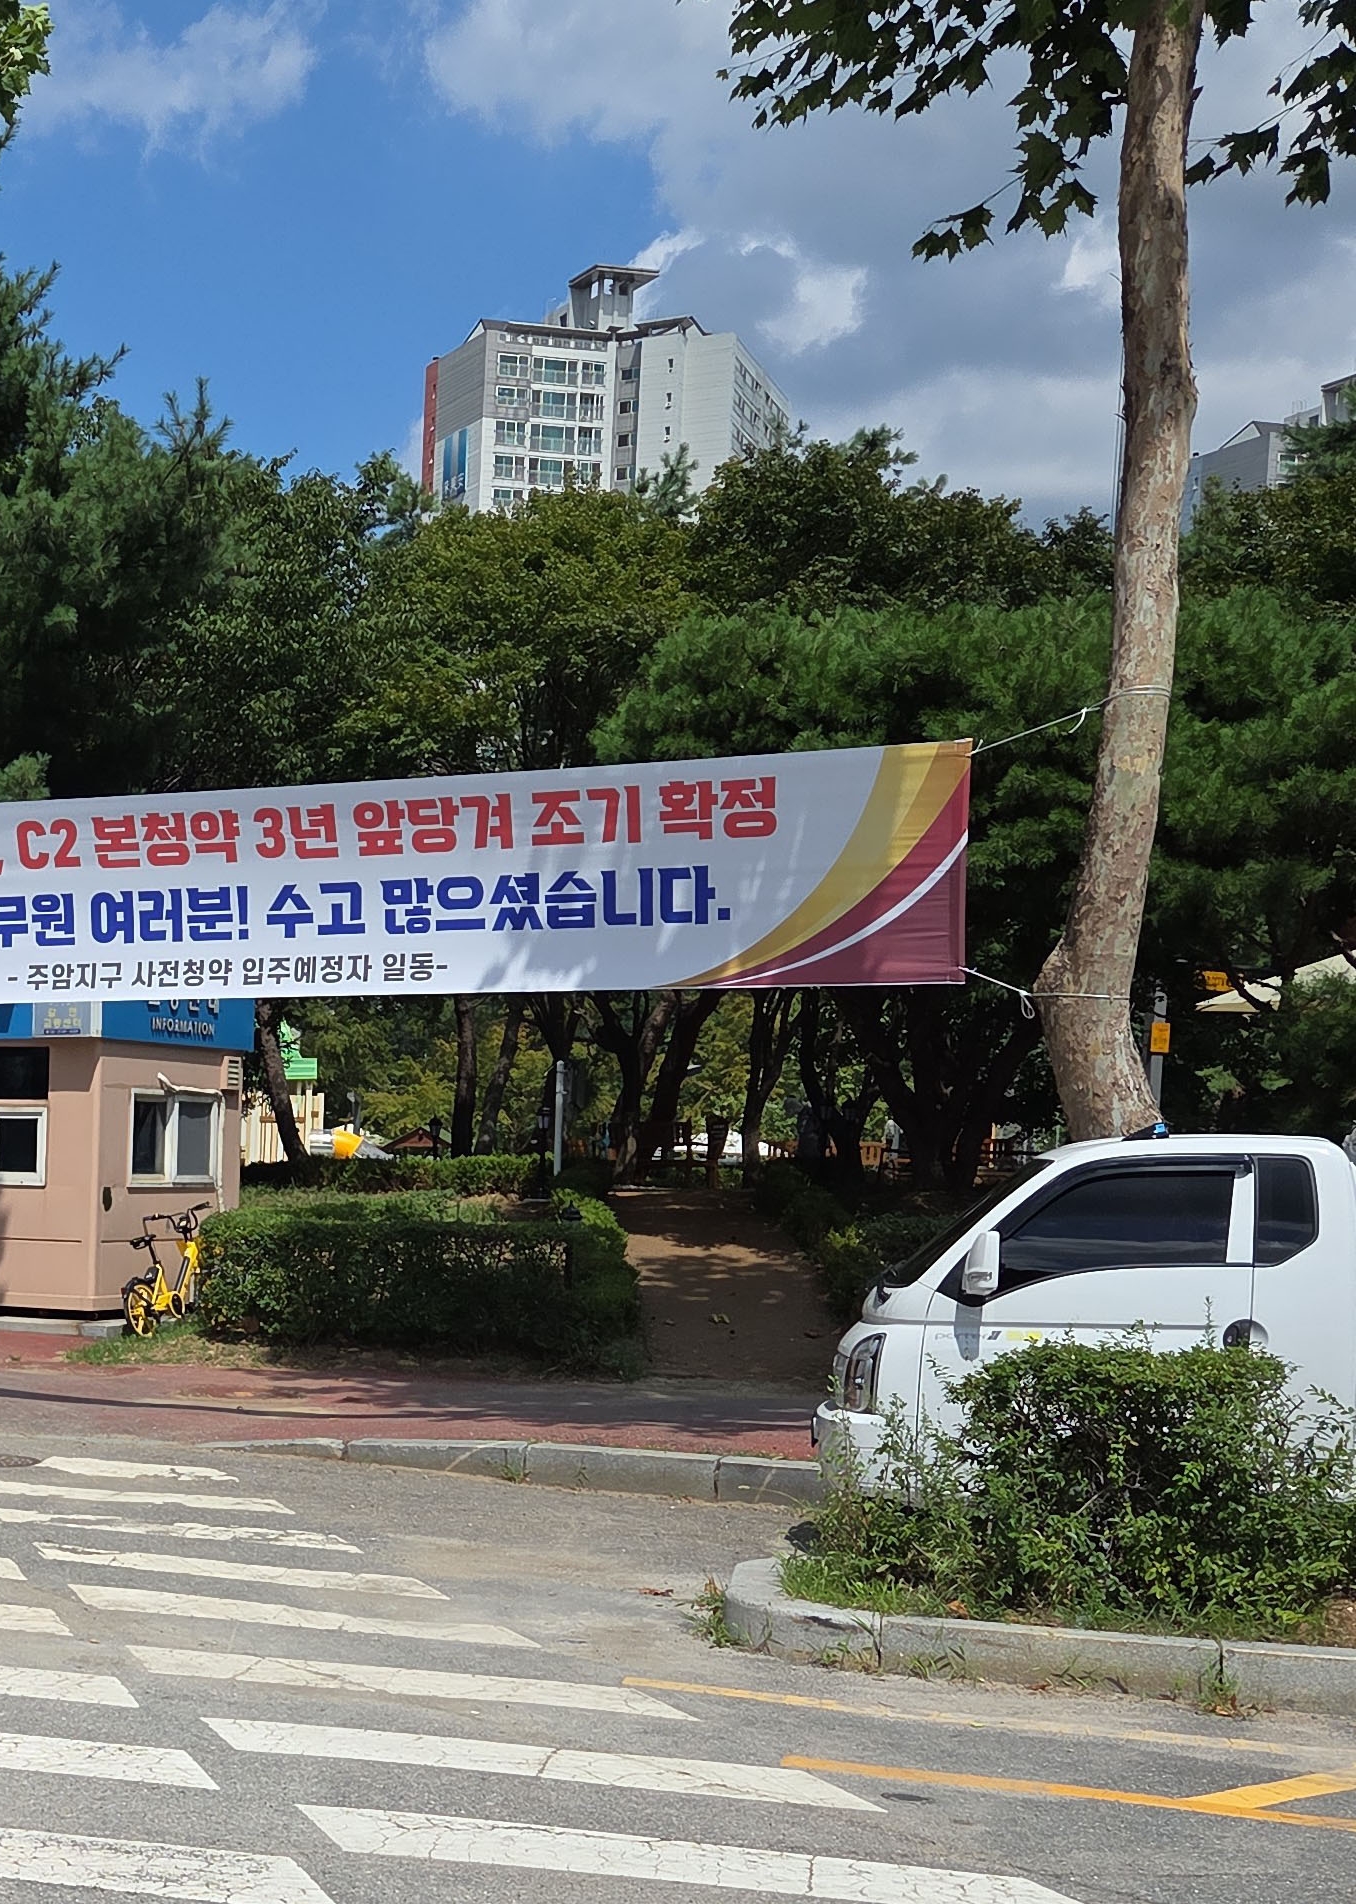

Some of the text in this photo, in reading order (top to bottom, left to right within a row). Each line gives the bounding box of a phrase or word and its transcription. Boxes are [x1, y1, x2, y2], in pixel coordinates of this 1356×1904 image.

[17, 820, 80, 869] C2
[93, 809, 239, 868] 본청약
[254, 805, 338, 859] 3년
[354, 793, 513, 856] 앞당겨
[532, 788, 640, 846] 조기
[660, 776, 776, 840] 확정
[90, 885, 250, 945] 여러분!
[265, 881, 367, 939] 수고
[380, 865, 731, 936] 많으셨습니다.
[26, 962, 123, 990] 주암지구
[130, 959, 233, 989] 사전청약
[242, 955, 373, 986] 입주예정자
[151, 1016, 216, 1036] INFORMATION
